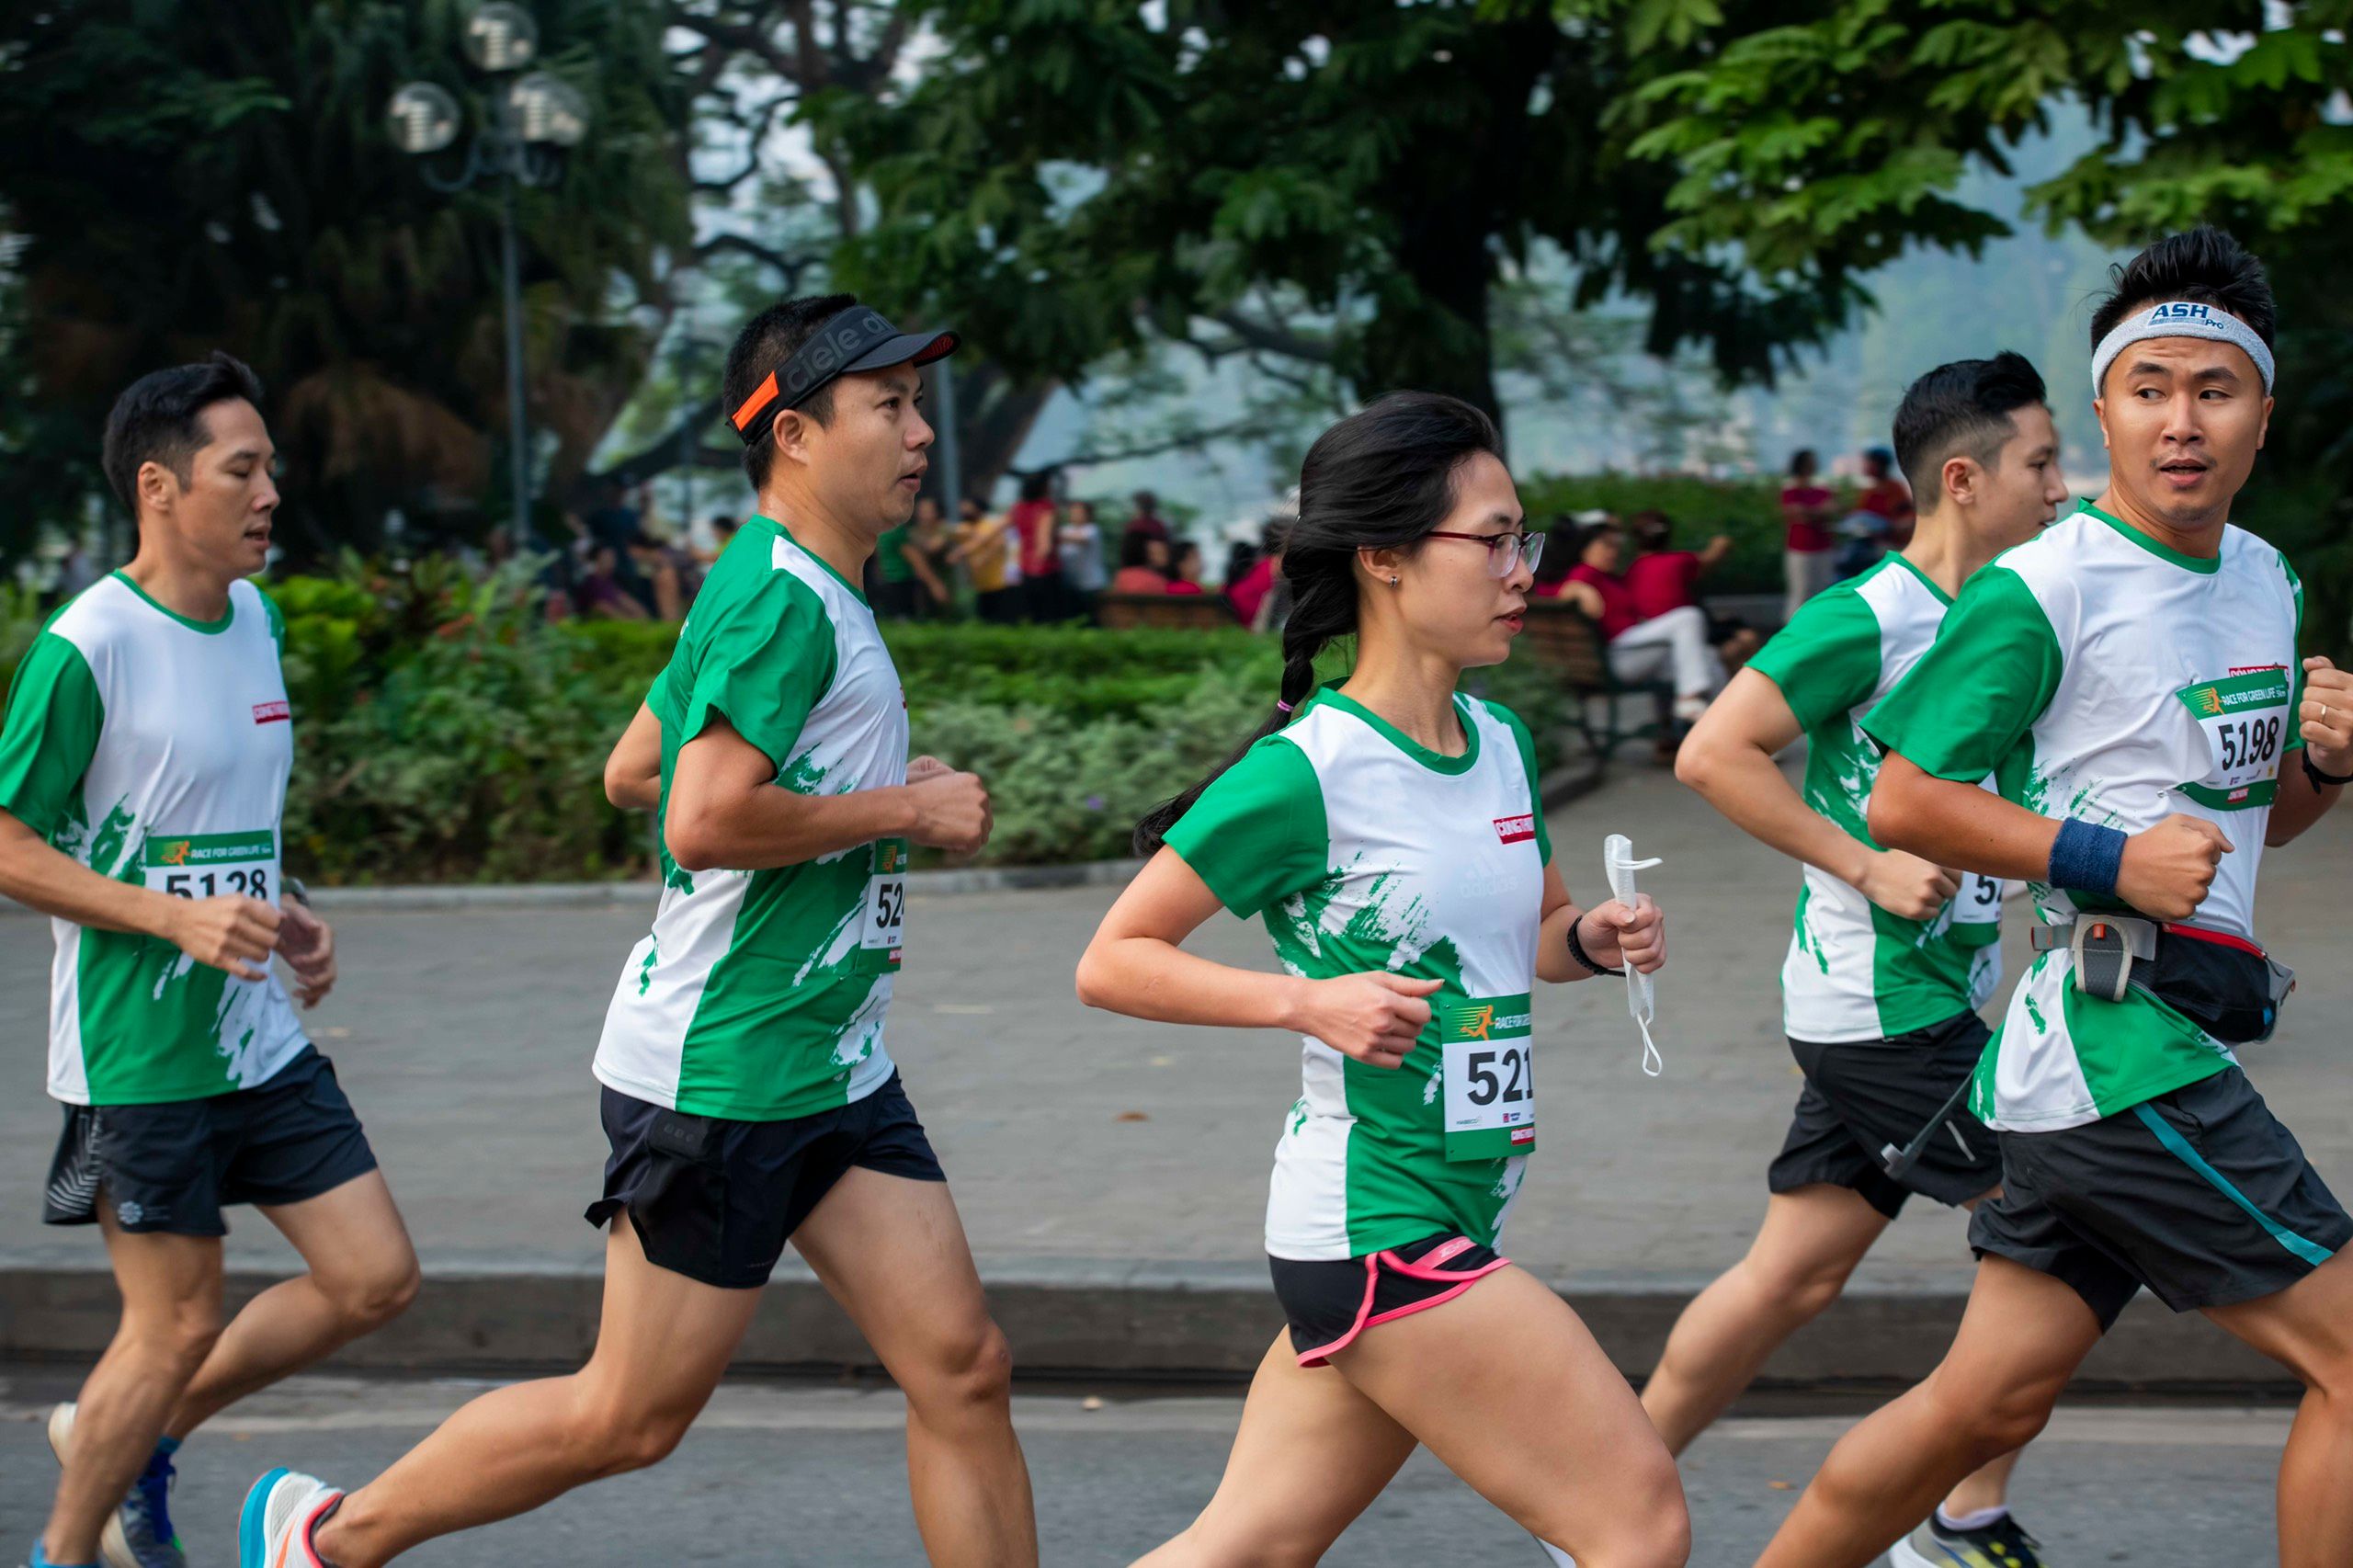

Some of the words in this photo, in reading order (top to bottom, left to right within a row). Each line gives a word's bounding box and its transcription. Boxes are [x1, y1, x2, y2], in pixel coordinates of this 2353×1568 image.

[2152, 303, 2210, 319] ASH
[2205, 318, 2224, 330] Pro
[786, 328, 861, 392] ciele
[2222, 695, 2238, 706] RACE
[2237, 692, 2249, 702] FOR
[2248, 688, 2266, 701] GREEN
[2266, 687, 2276, 699] LIFE
[2217, 716, 2279, 771] 5198
[190, 847, 211, 858] RACE
[212, 847, 227, 858] FOR
[876, 881, 904, 928] 52
[1974, 872, 2002, 905] 5
